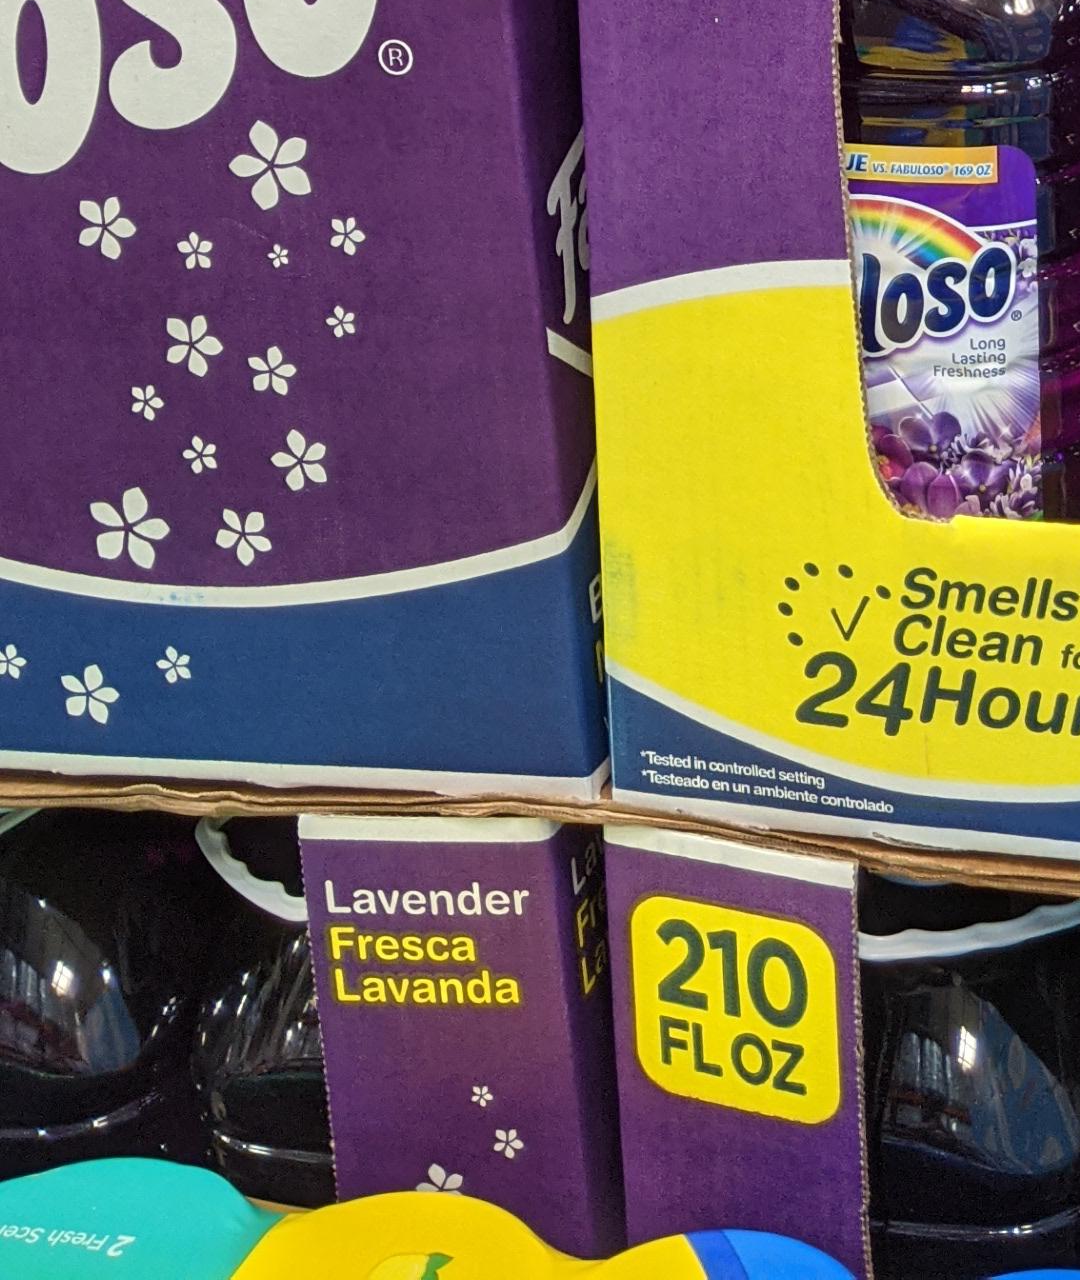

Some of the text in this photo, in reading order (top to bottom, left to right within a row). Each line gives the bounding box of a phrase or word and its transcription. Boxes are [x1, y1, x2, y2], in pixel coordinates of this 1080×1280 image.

[872, 162, 888, 174] VS.
[954, 164, 973, 176] 169
[976, 164, 992, 176] OZ
[952, 352, 1007, 366] Lasting
[970, 338, 1006, 351] Long
[933, 365, 1007, 378] Freshness
[900, 566, 1080, 623] Smells
[893, 614, 1044, 666] Clean
[694, 755, 706, 771] in
[708, 758, 776, 781] controlled
[778, 766, 825, 790] setting
[711, 779, 730, 792] en
[731, 781, 750, 795] un
[753, 782, 818, 804] ambiente
[820, 790, 894, 814] controlado
[324, 879, 530, 917] Lavender
[330, 926, 476, 962] Fresca
[334, 969, 520, 1005] Lavanda
[655, 919, 809, 1029] 210
[659, 1014, 807, 1096] FL OZ
[0, 1224, 136, 1257] 2 Fresh Sce
